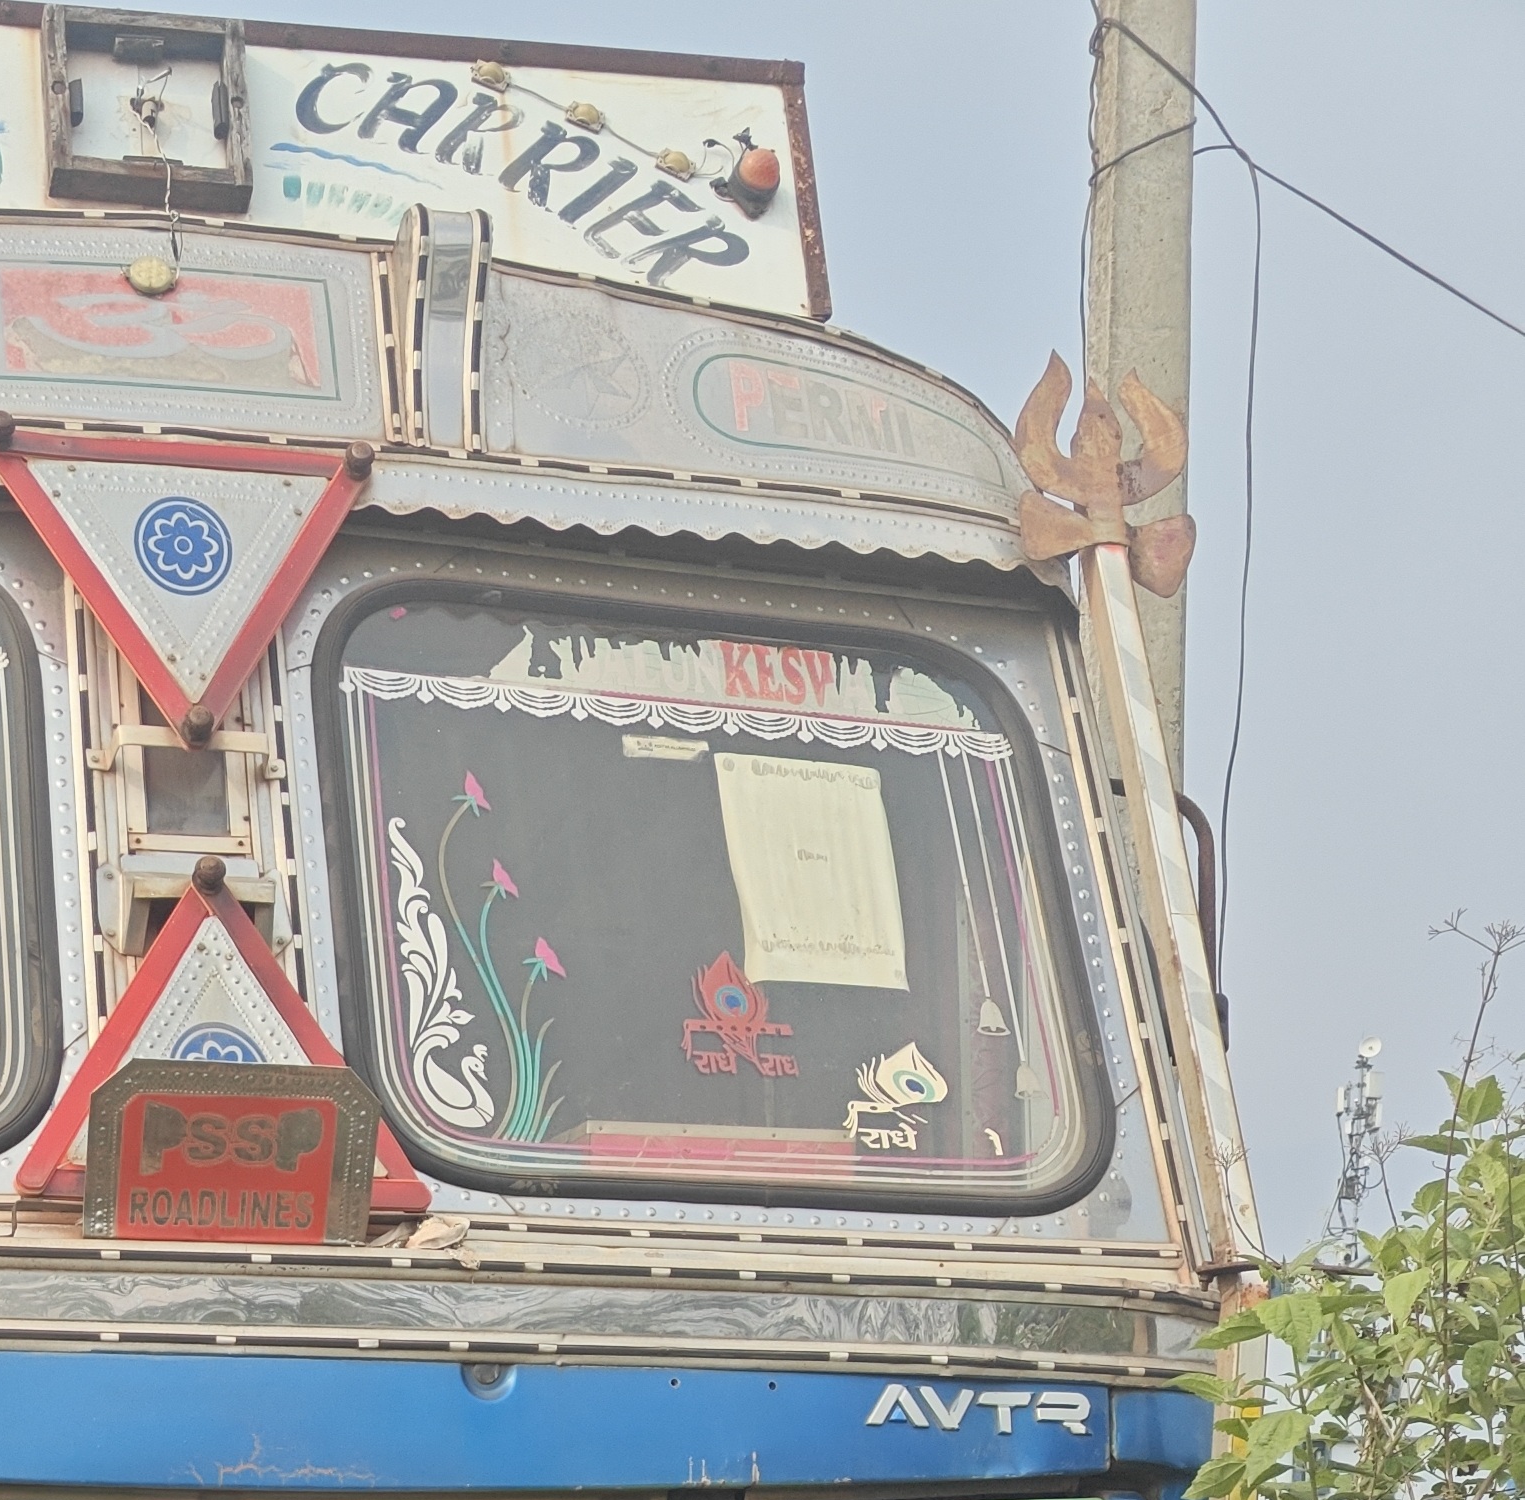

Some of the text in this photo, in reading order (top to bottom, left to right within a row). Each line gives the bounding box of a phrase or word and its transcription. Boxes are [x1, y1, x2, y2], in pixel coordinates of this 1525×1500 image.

[295, 61, 749, 288] CARRIER
[140, 1100, 323, 1176] PSSP
[858, 1122, 918, 1150] राधे
[129, 1188, 314, 1229] ROADLINES
[865, 1383, 1092, 1436] AVTR
